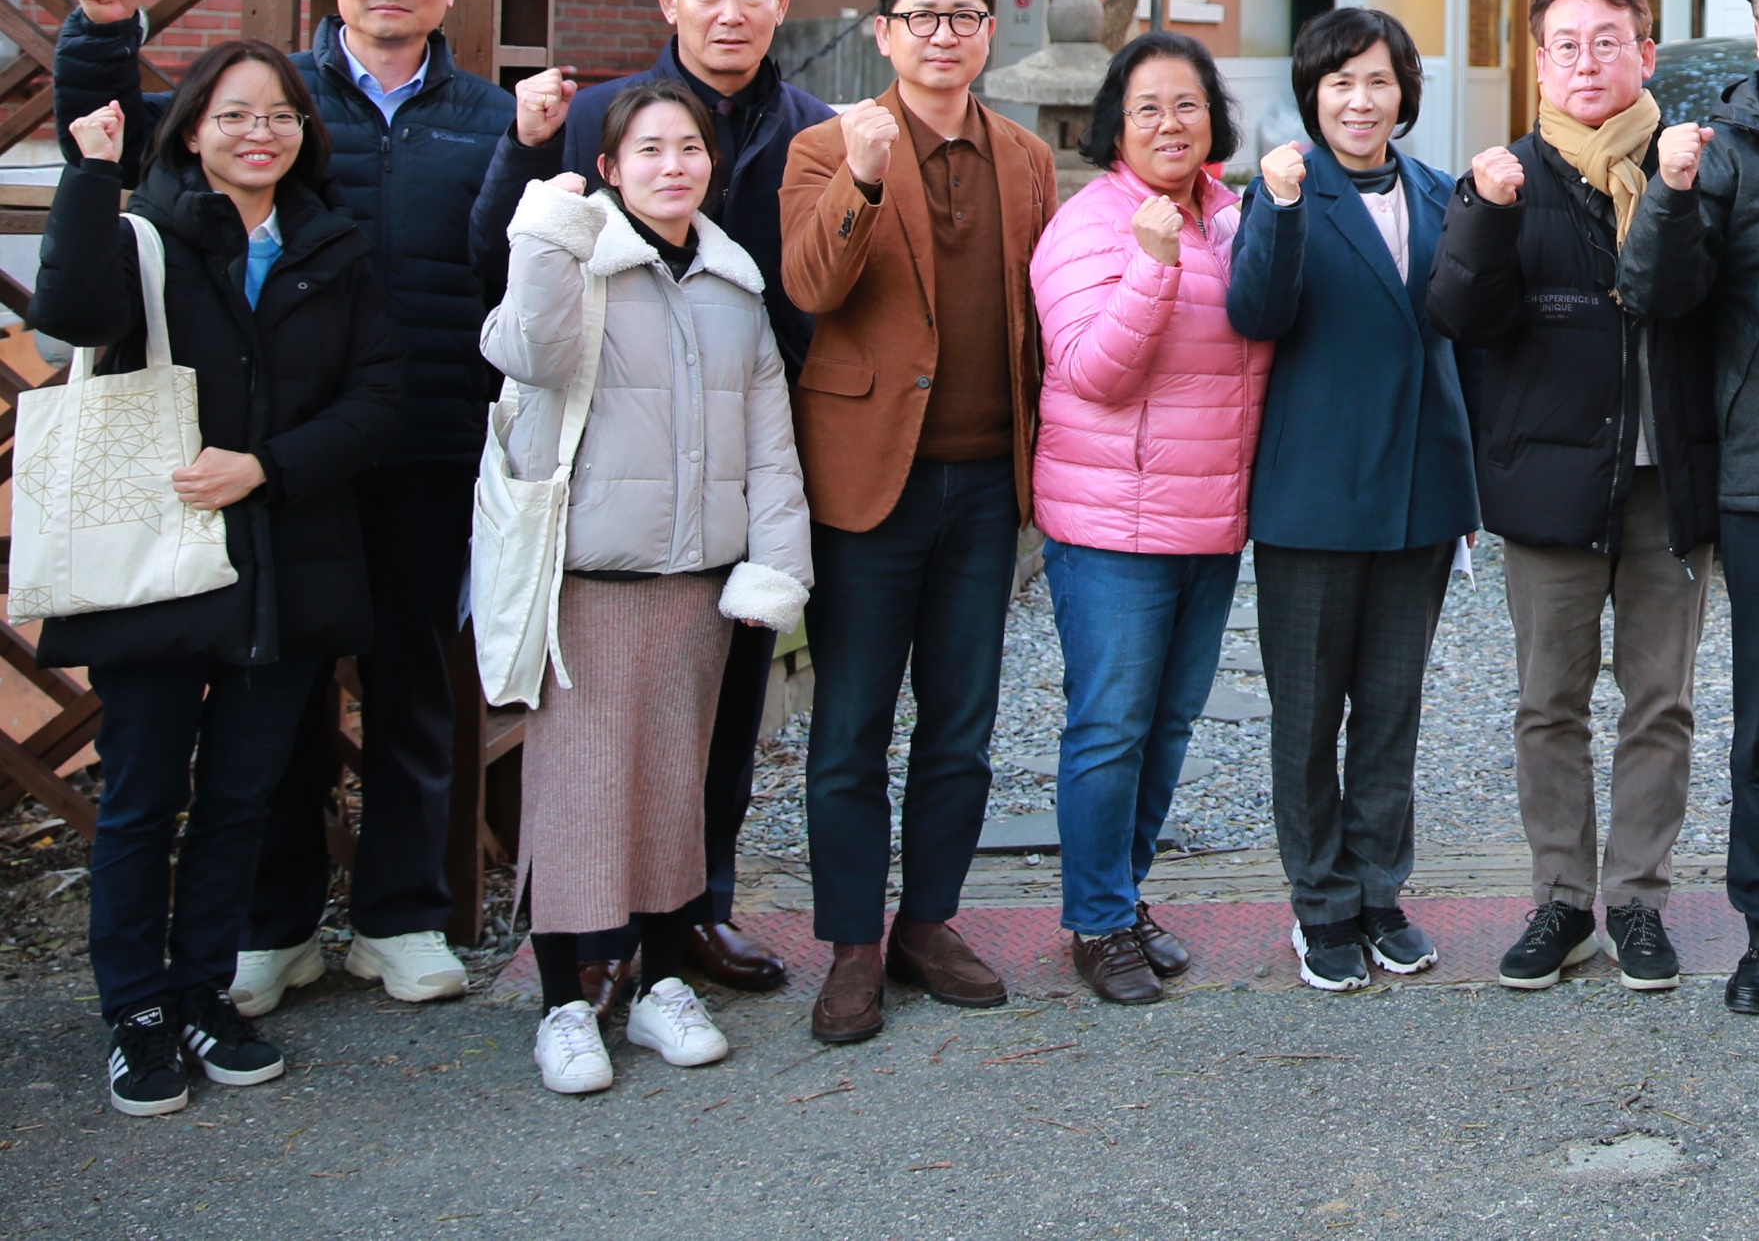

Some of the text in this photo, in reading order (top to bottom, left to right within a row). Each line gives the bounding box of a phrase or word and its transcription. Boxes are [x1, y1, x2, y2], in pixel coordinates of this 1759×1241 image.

[1539, 294, 1590, 304] EXPERIENCE
[1591, 297, 1599, 305] IS
[1540, 303, 1573, 312] UNIQUE
